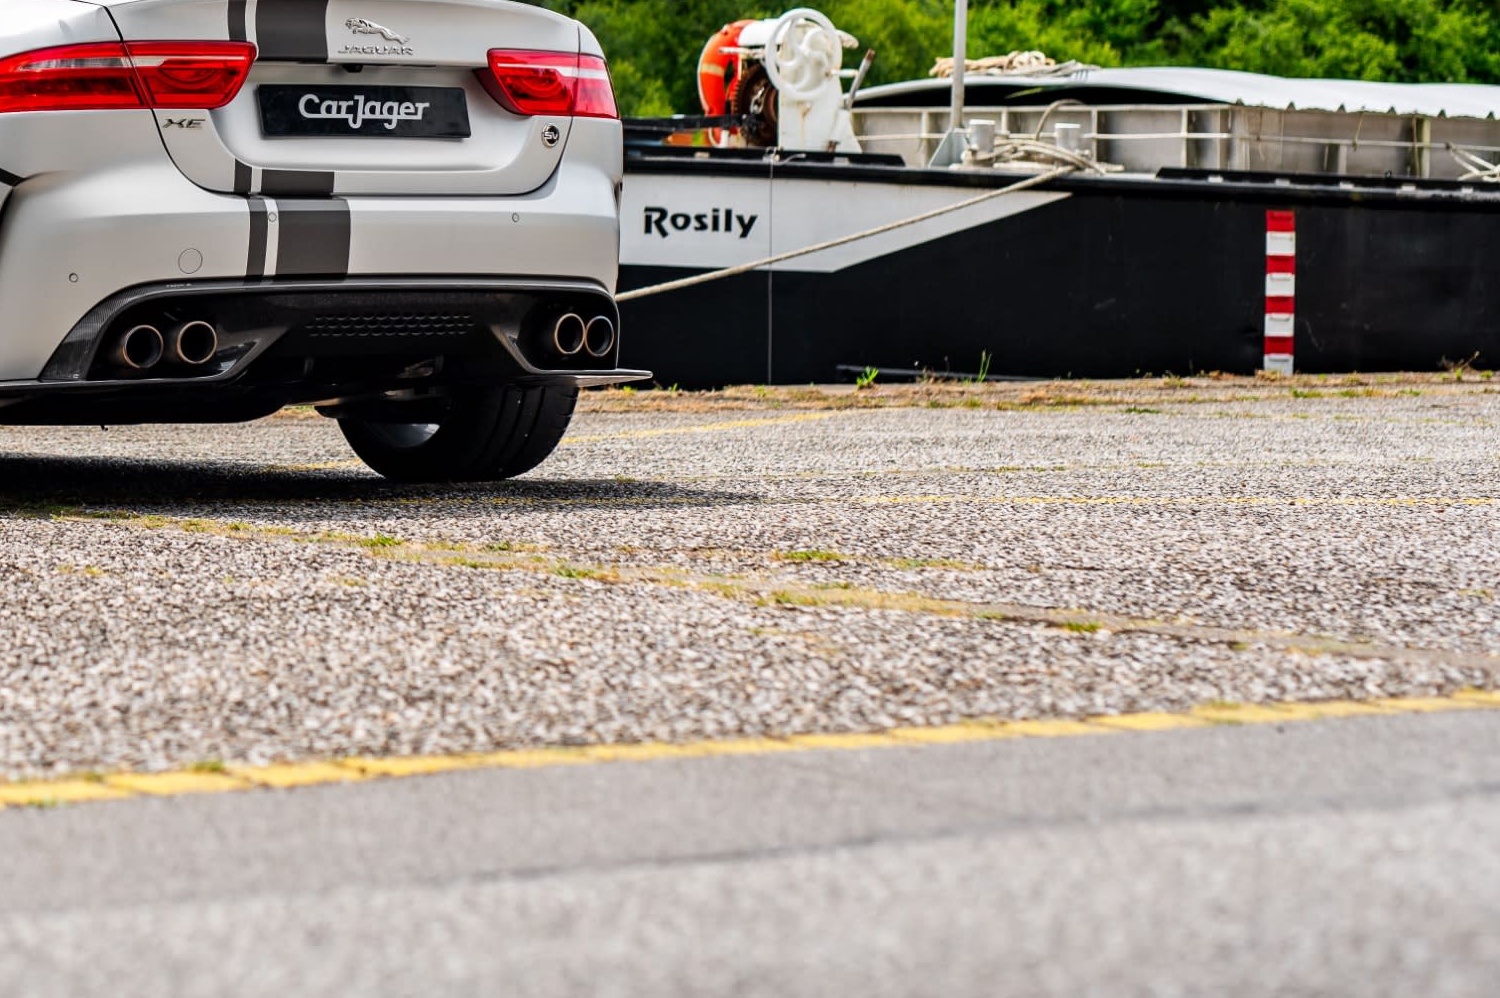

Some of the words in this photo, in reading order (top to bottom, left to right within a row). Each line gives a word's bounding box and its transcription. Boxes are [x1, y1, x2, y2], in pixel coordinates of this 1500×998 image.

[337, 45, 413, 56] JAGUAR
[298, 93, 430, 130] CarJager
[643, 206, 758, 239] Rosily
